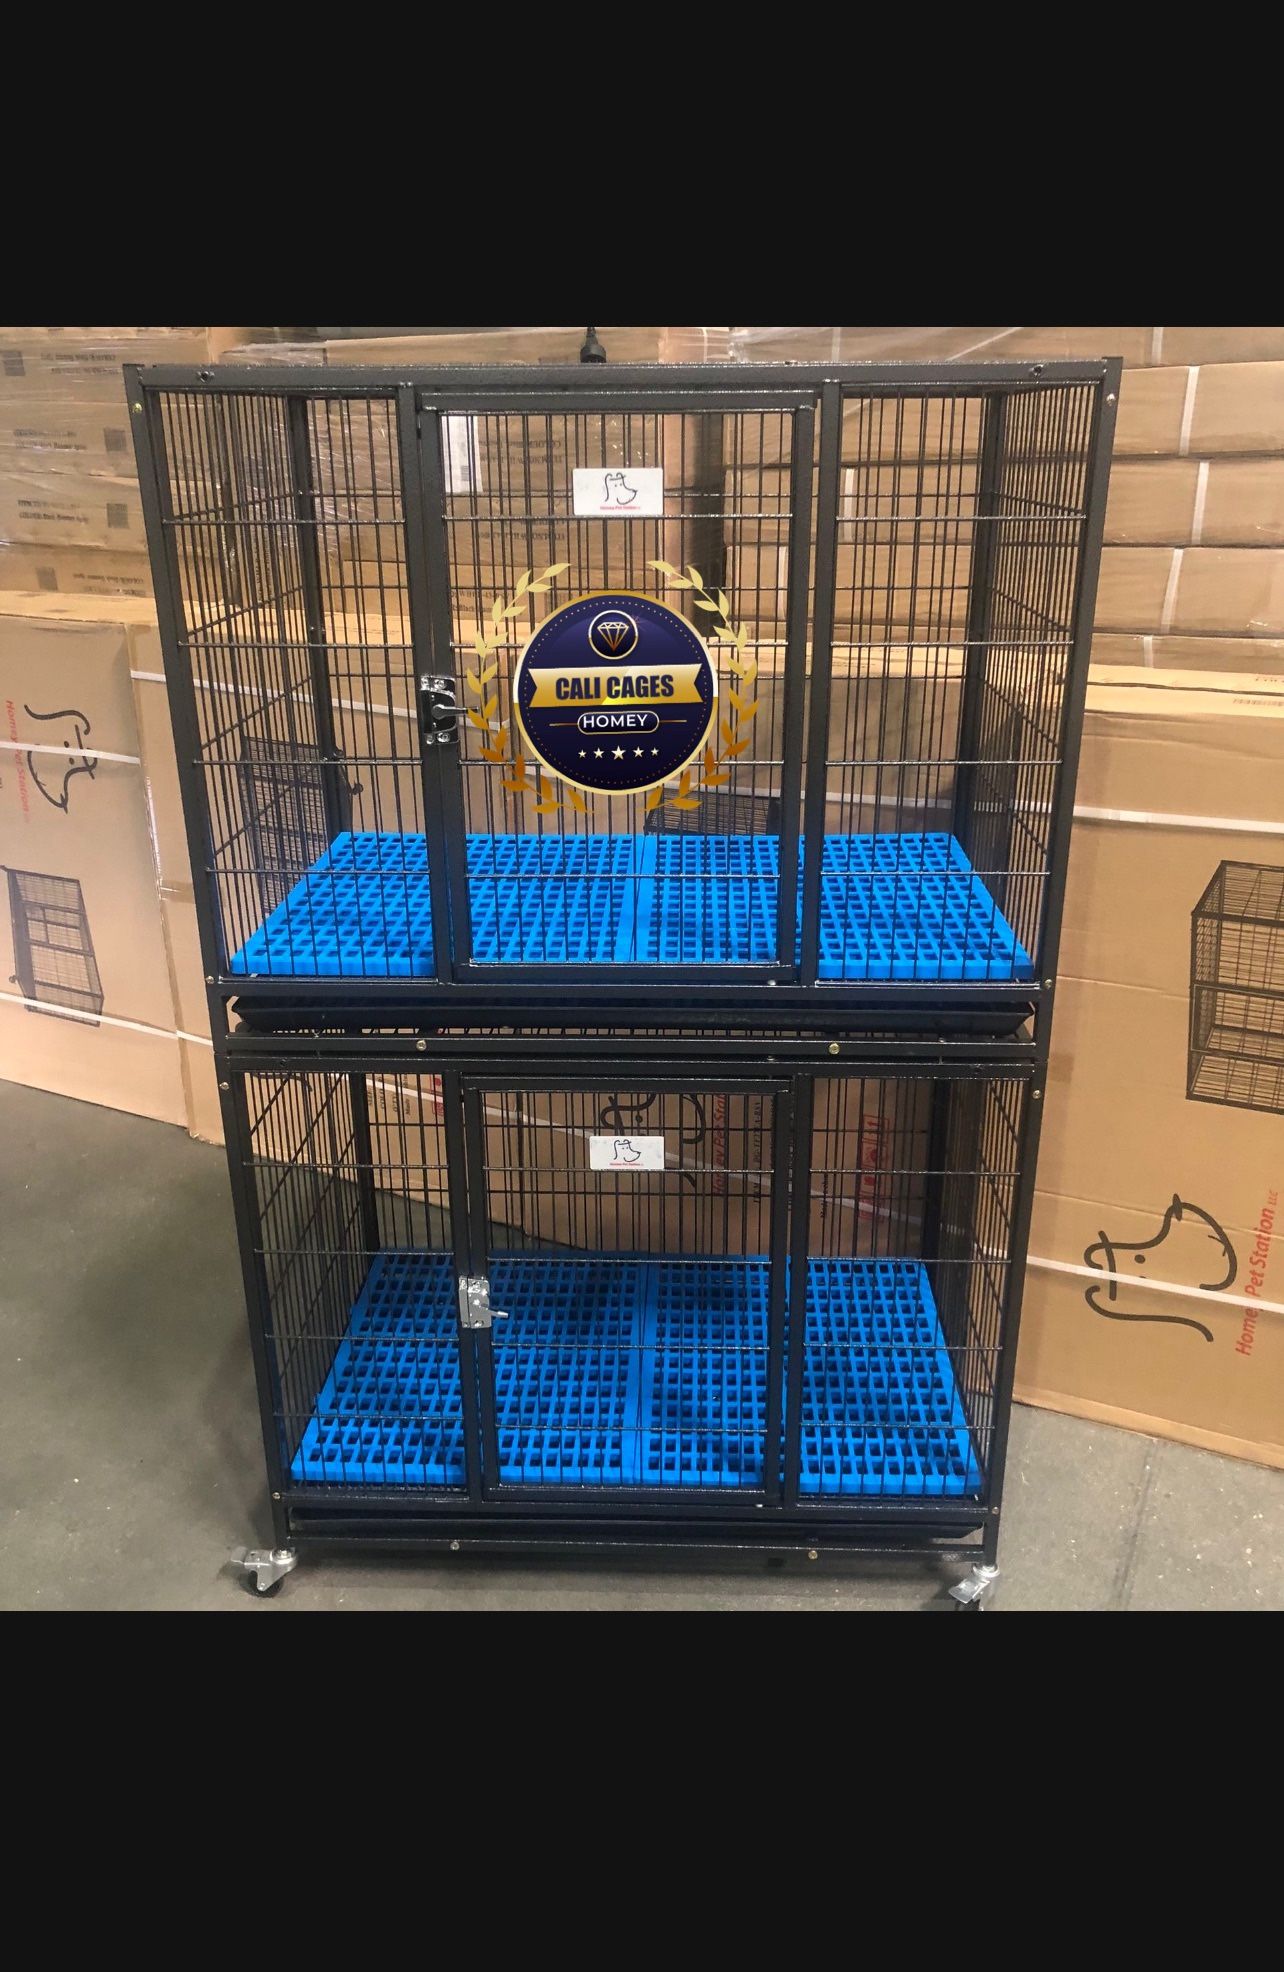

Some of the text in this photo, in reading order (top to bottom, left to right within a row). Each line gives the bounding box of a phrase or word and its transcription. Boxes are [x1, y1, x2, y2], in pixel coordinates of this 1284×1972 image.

[1235, 1189, 1279, 1356] Home Pet Station LLC
